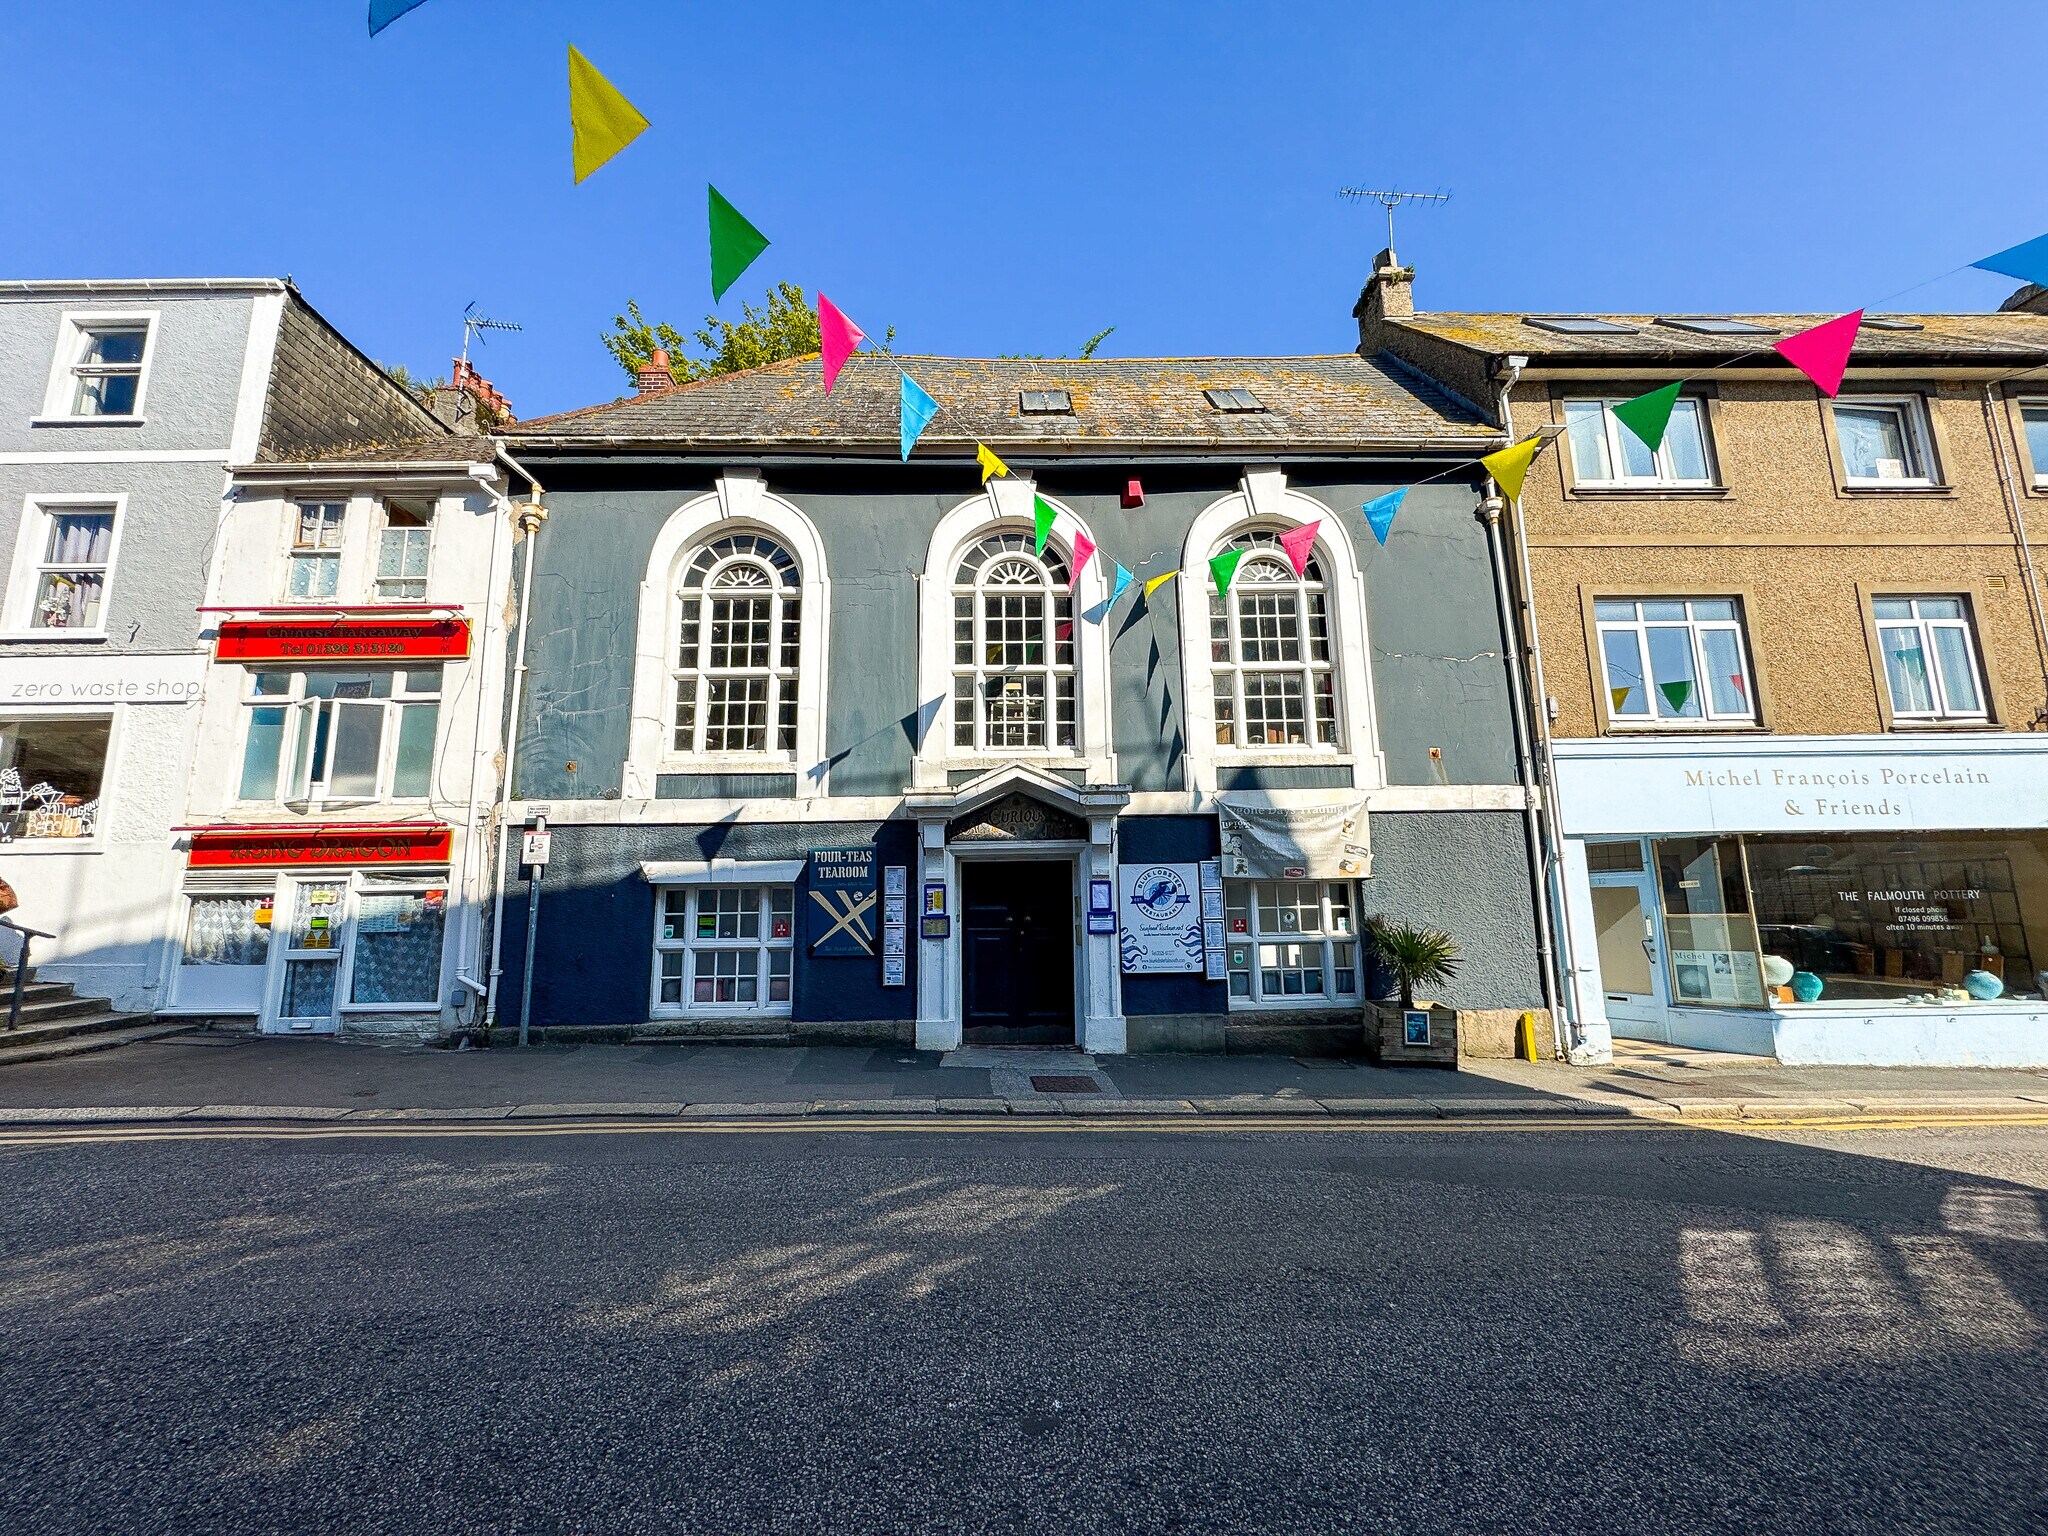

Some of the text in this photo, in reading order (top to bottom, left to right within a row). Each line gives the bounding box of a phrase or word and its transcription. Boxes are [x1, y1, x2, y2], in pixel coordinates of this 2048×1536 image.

[267, 624, 423, 639] Chinese Takeaway
[281, 643, 303, 654] Tel
[307, 643, 349, 654] 01326
[11, 678, 200, 700] zero waste shop
[1685, 768, 1990, 788] Michel François Porcelain
[1784, 798, 1902, 815] & Friends
[230, 837, 411, 859] RISING DRAGON
[814, 850, 873, 863] FOUR-TEAS
[818, 866, 868, 878] TEAROOM
[1138, 870, 1182, 889] BLUE LOBSTER
[1838, 890, 1980, 901] THE FALMOUTH POTTERY
[1142, 905, 1179, 918] RESTAURANT
[1927, 906, 1948, 914] phone
[1946, 924, 1963, 932] away
[1674, 952, 1706, 960] Michel
